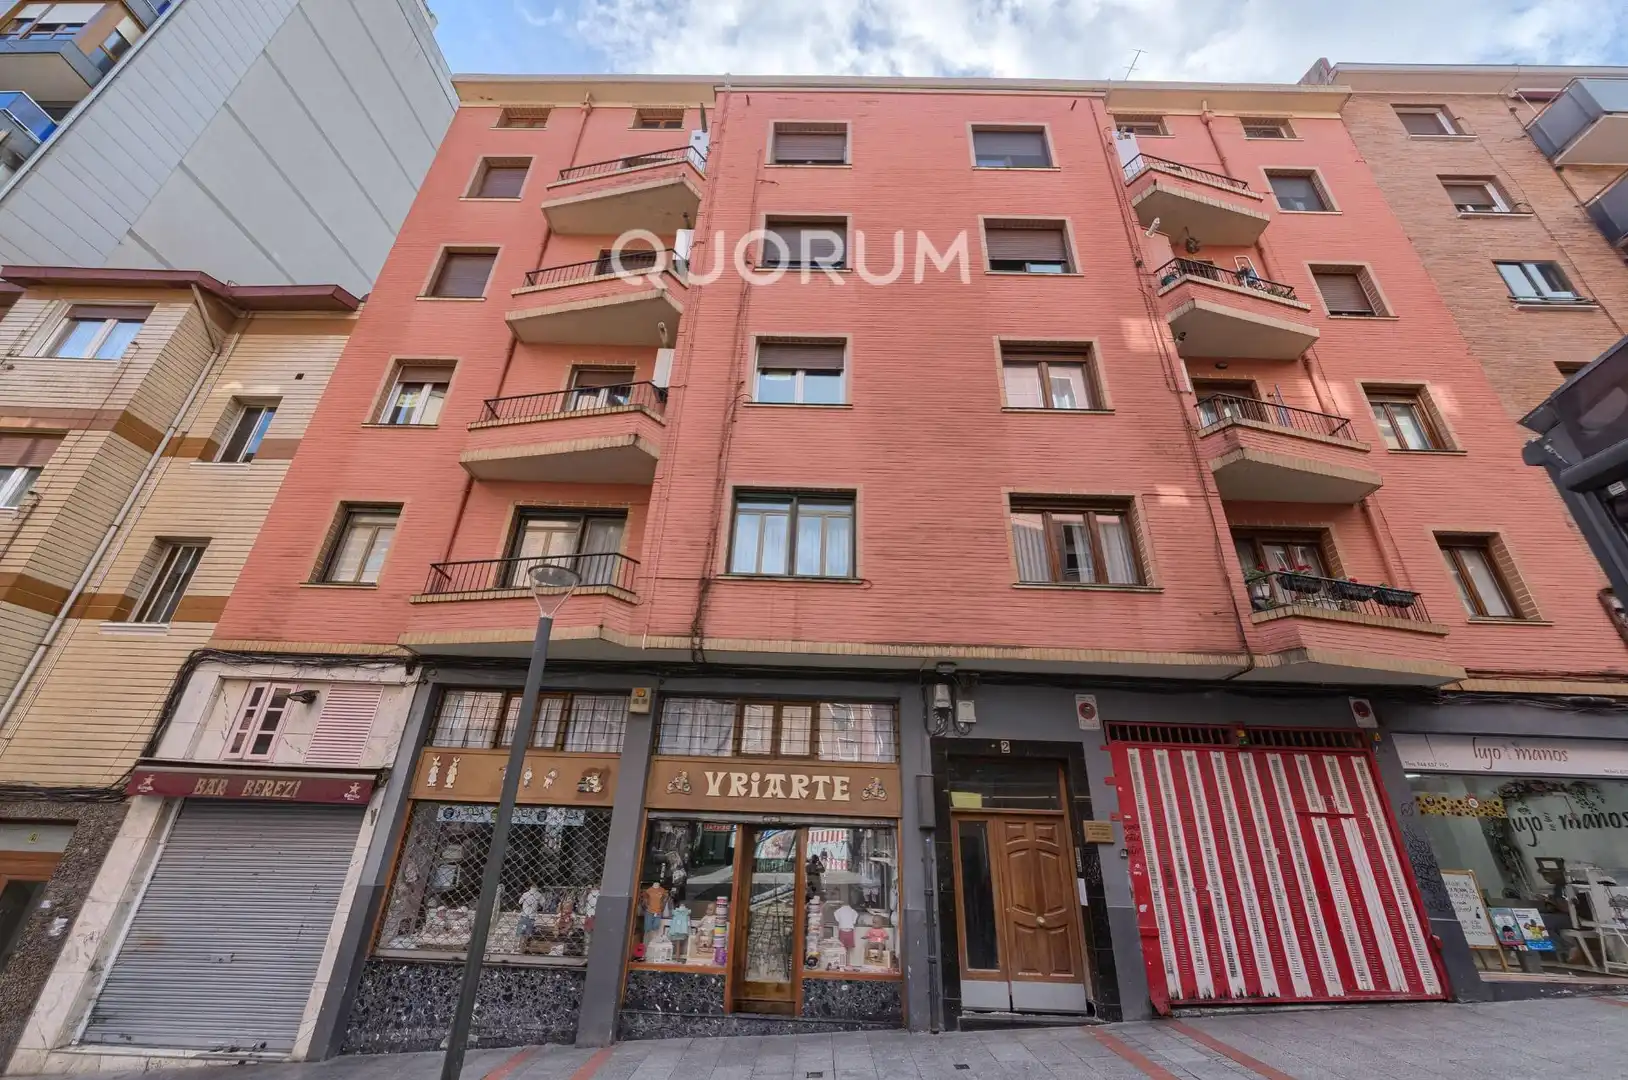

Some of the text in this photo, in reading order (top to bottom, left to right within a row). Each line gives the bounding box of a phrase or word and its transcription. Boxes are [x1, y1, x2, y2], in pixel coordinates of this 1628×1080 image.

[1473, 737, 1501, 769] lujo
[1515, 747, 1568, 762] manos
[192, 777, 229, 796] BAR
